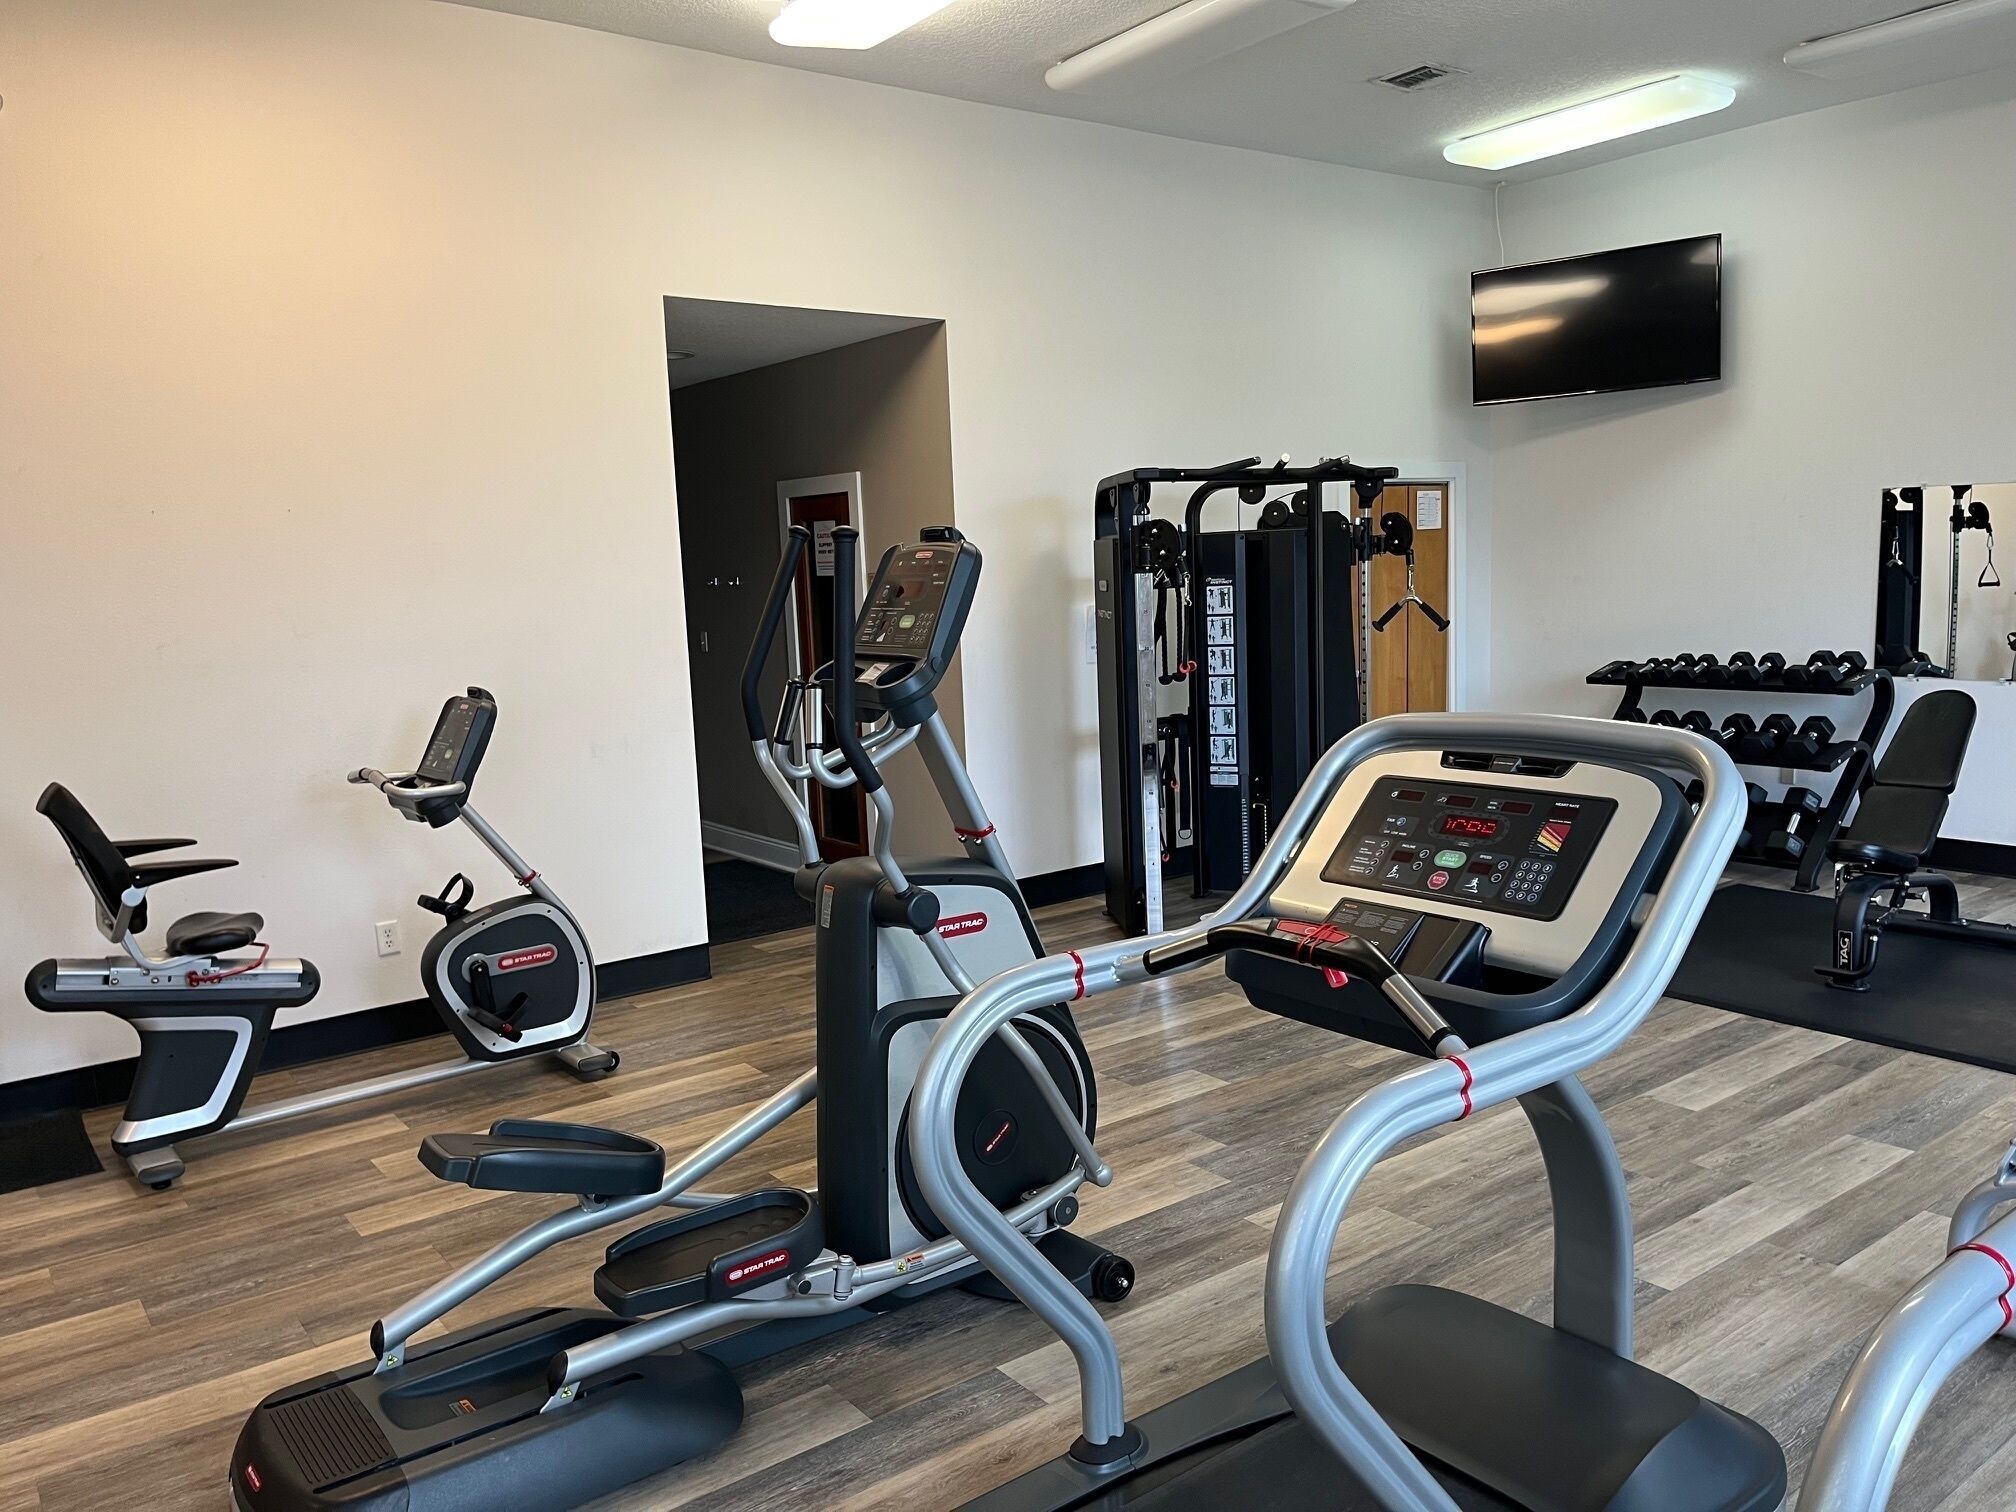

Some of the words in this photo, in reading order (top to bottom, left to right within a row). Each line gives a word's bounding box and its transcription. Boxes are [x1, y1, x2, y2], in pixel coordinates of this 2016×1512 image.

[938, 924, 961, 934] STAR
[960, 918, 984, 928] TRAC
[514, 955, 532, 963] STAR
[533, 951, 552, 960] TRAC
[1840, 936, 1850, 965] TAG
[743, 1262, 764, 1275] STAR
[764, 1254, 786, 1269] TRAC
